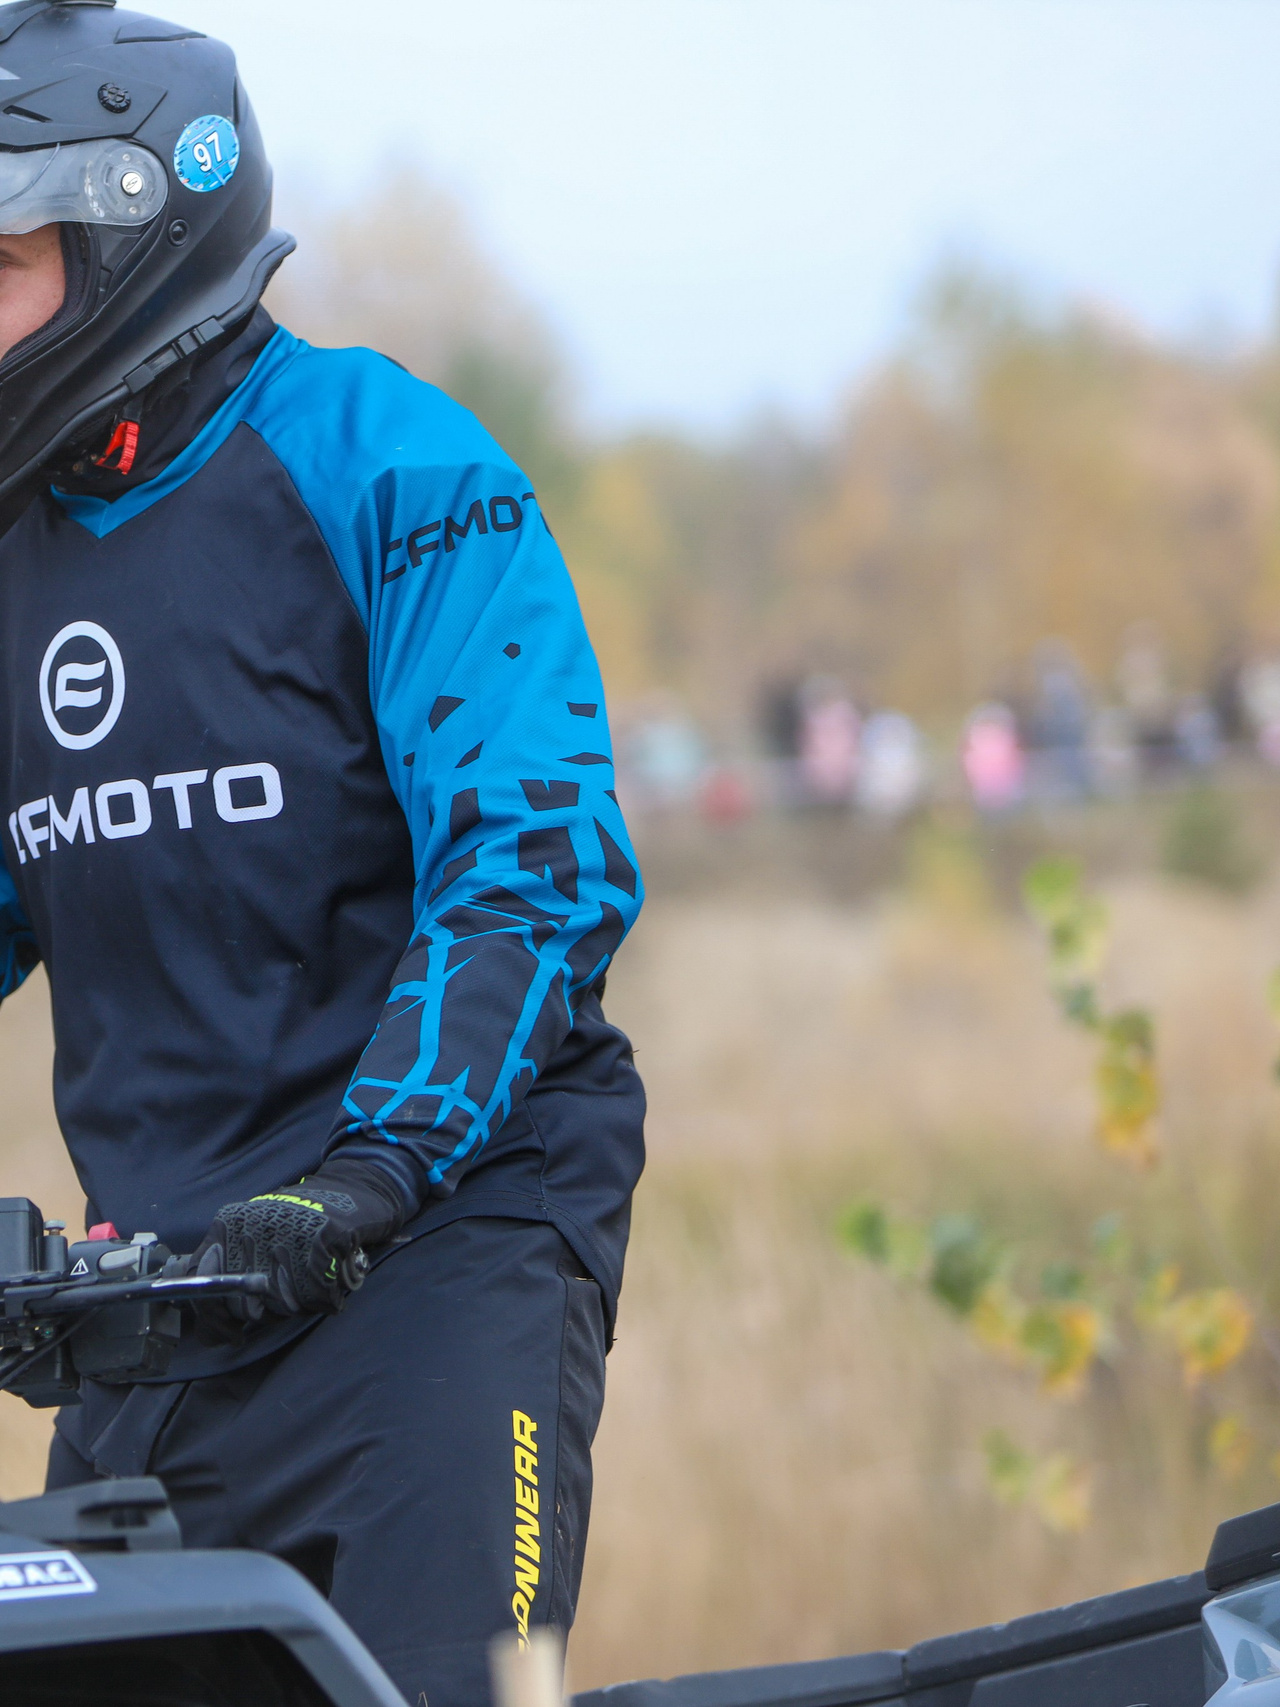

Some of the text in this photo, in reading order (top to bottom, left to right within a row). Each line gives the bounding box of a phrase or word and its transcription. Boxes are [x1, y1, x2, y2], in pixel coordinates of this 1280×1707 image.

[192, 130, 223, 173] 97
[383, 492, 552, 584] CFMO
[512, 1409, 541, 1651] ONWEAR
